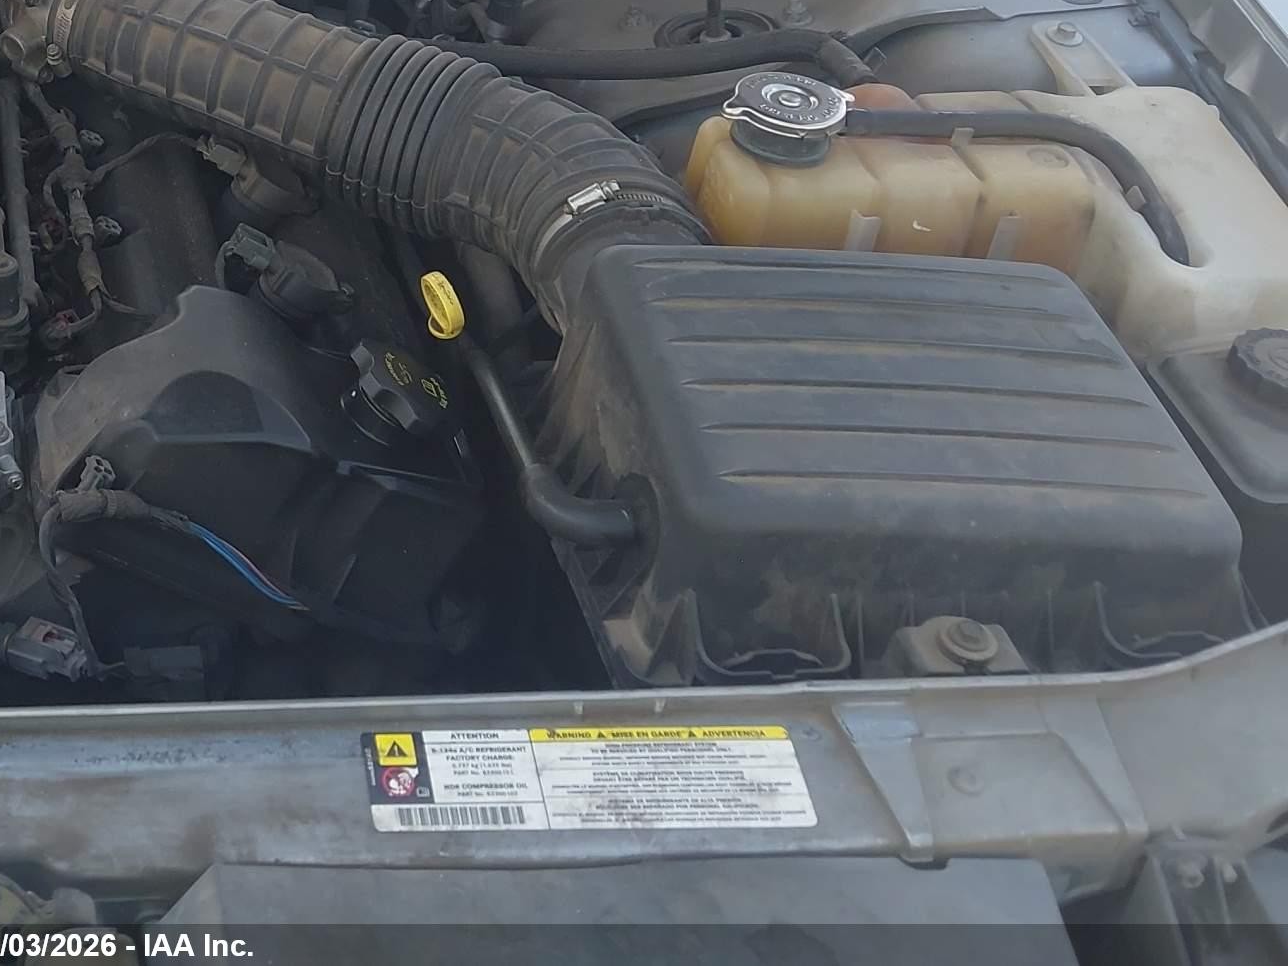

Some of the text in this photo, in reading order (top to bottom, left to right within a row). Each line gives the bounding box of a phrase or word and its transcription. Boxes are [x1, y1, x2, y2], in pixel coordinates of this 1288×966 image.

[450, 732, 500, 740] ATTENTION
[546, 730, 592, 739] WARNING
[636, 730, 649, 738] EN
[702, 729, 766, 737] ADVERTENCIA
